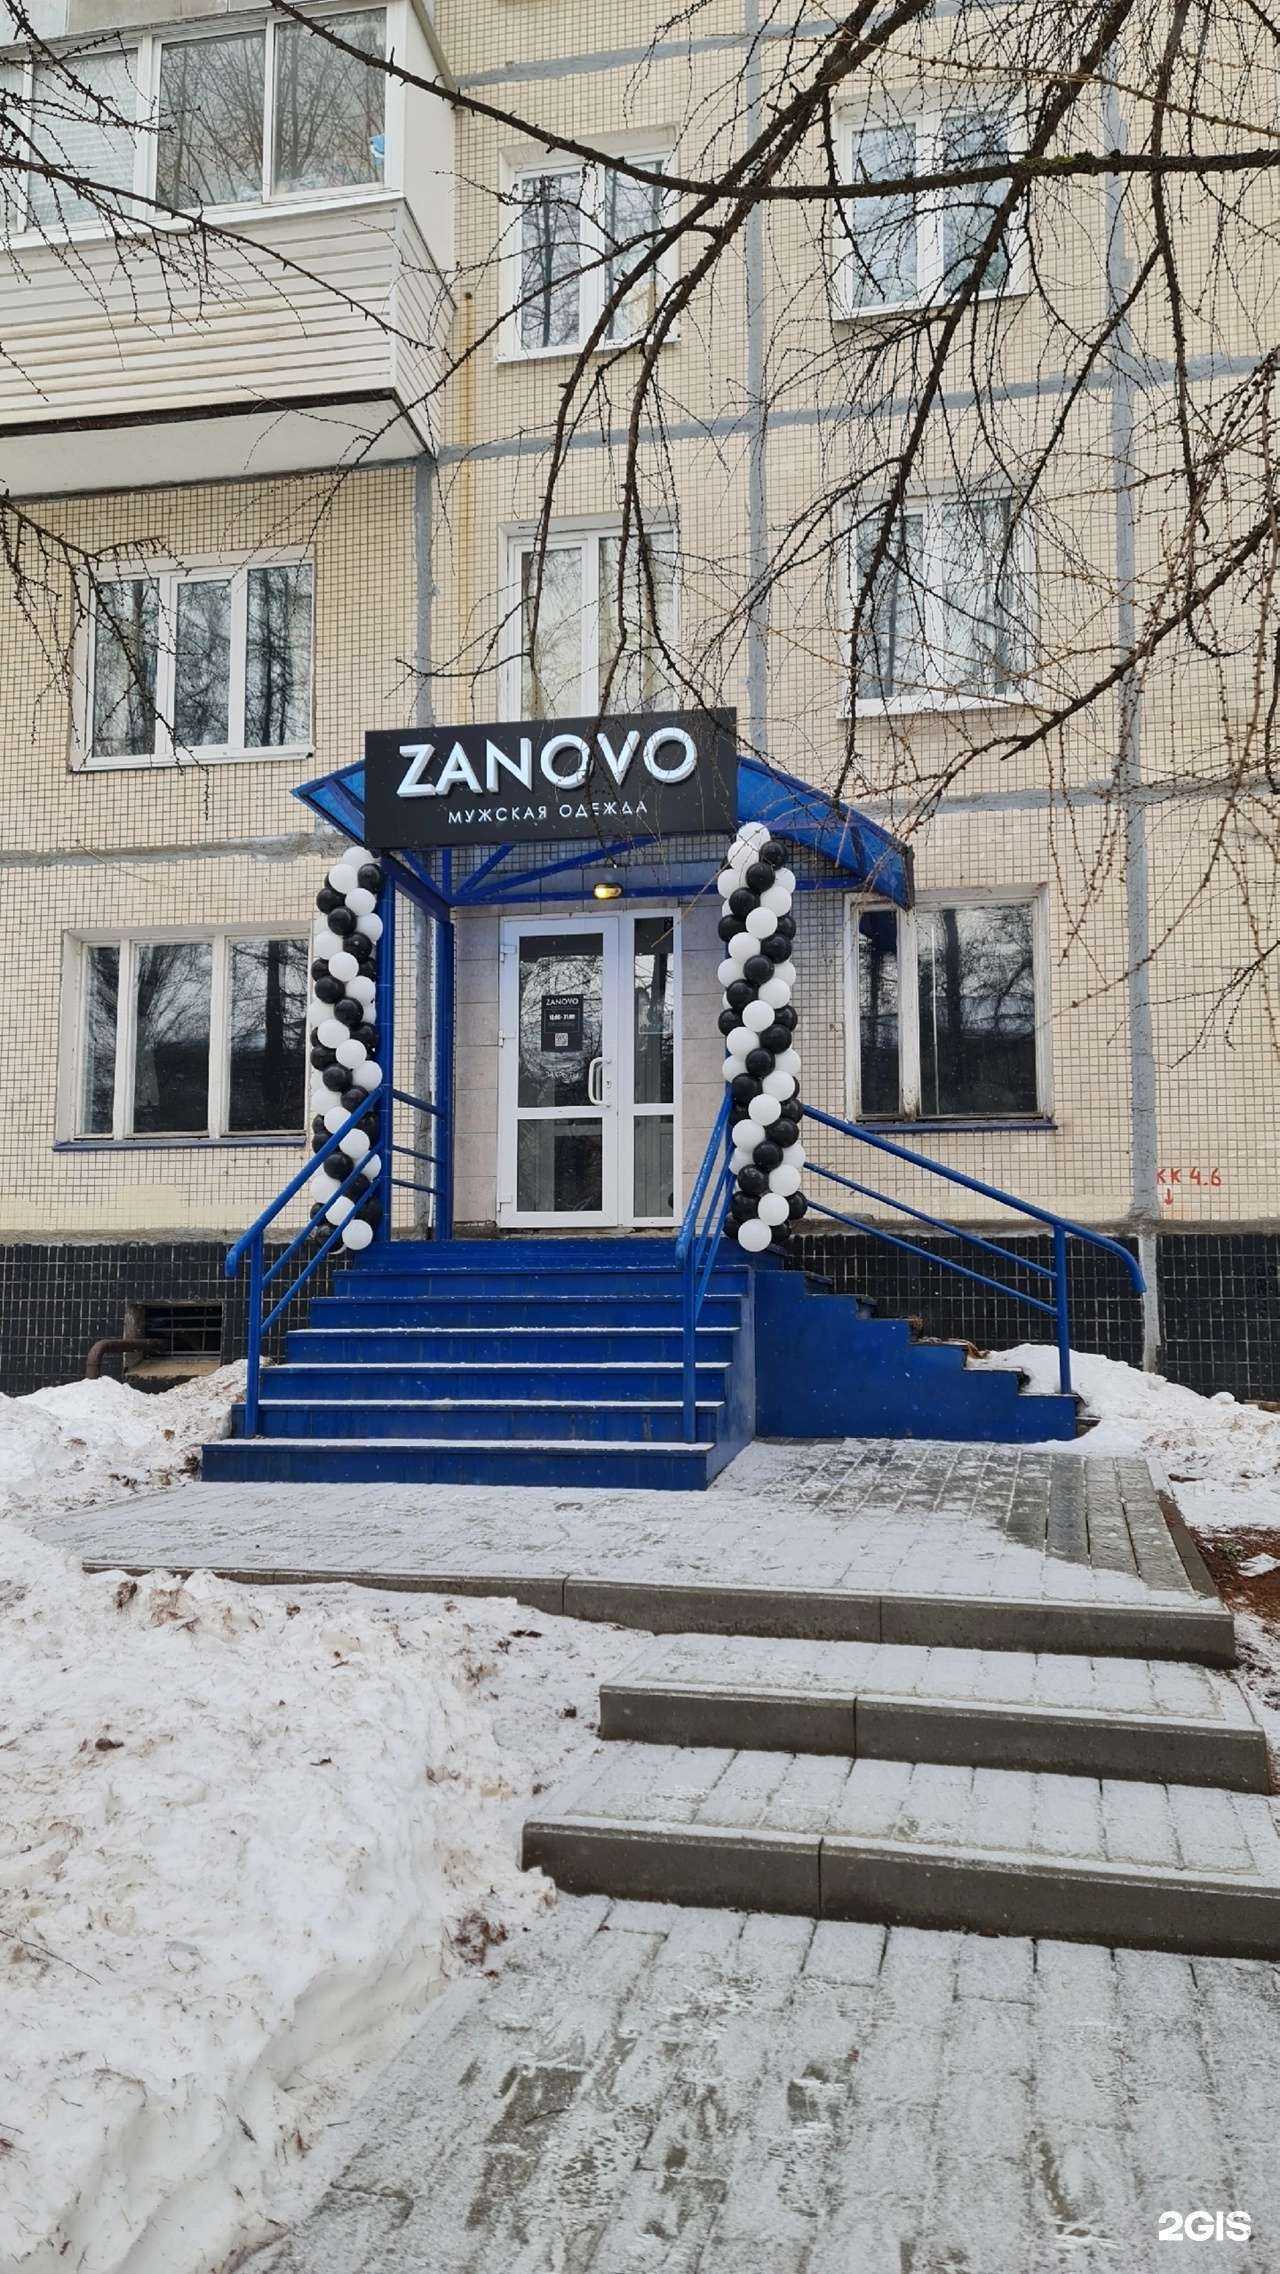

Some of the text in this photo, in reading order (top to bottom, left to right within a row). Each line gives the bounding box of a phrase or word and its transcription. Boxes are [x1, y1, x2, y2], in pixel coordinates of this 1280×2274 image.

[397, 727, 698, 797] ZANOVO
[448, 800, 648, 824] МУЖСКАЯ ОДЕЖДА
[1188, 1166, 1222, 1187] 4.6
